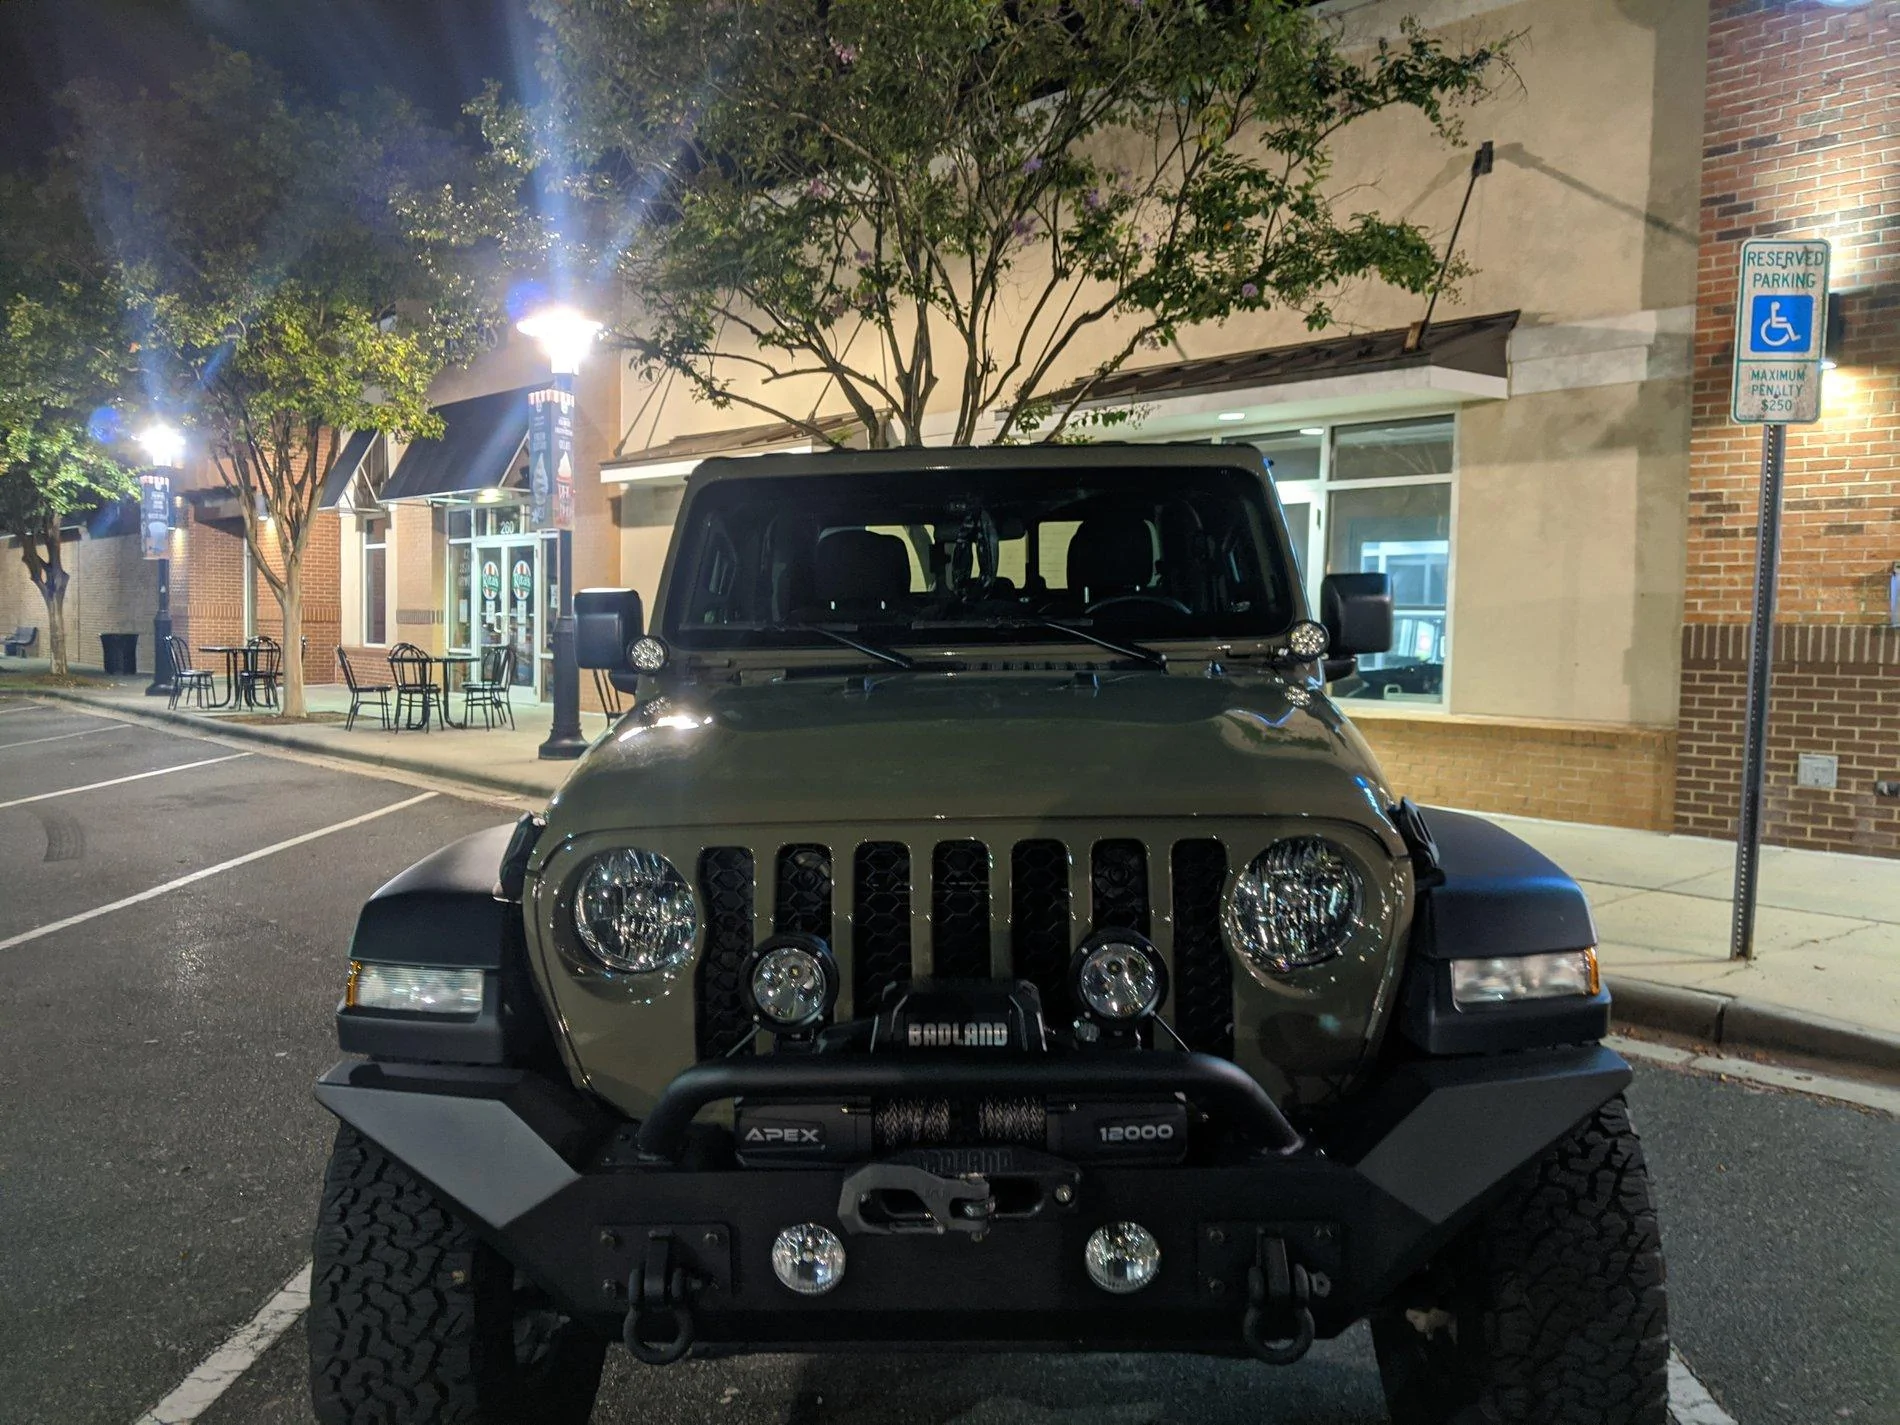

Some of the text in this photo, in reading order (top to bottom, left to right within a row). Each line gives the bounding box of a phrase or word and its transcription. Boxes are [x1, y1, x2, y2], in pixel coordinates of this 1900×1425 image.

[1747, 251, 1824, 267] RESERVED
[1753, 272, 1816, 288] PARKING
[1751, 369, 1806, 382] MAXIMUM
[1751, 384, 1804, 397] PENALTY
[1761, 399, 1792, 412] $250
[500, 520, 514, 534] 260
[908, 1022, 1008, 1047] BADLAND
[744, 1127, 820, 1142] APEX
[1099, 1124, 1174, 1142] 12000
